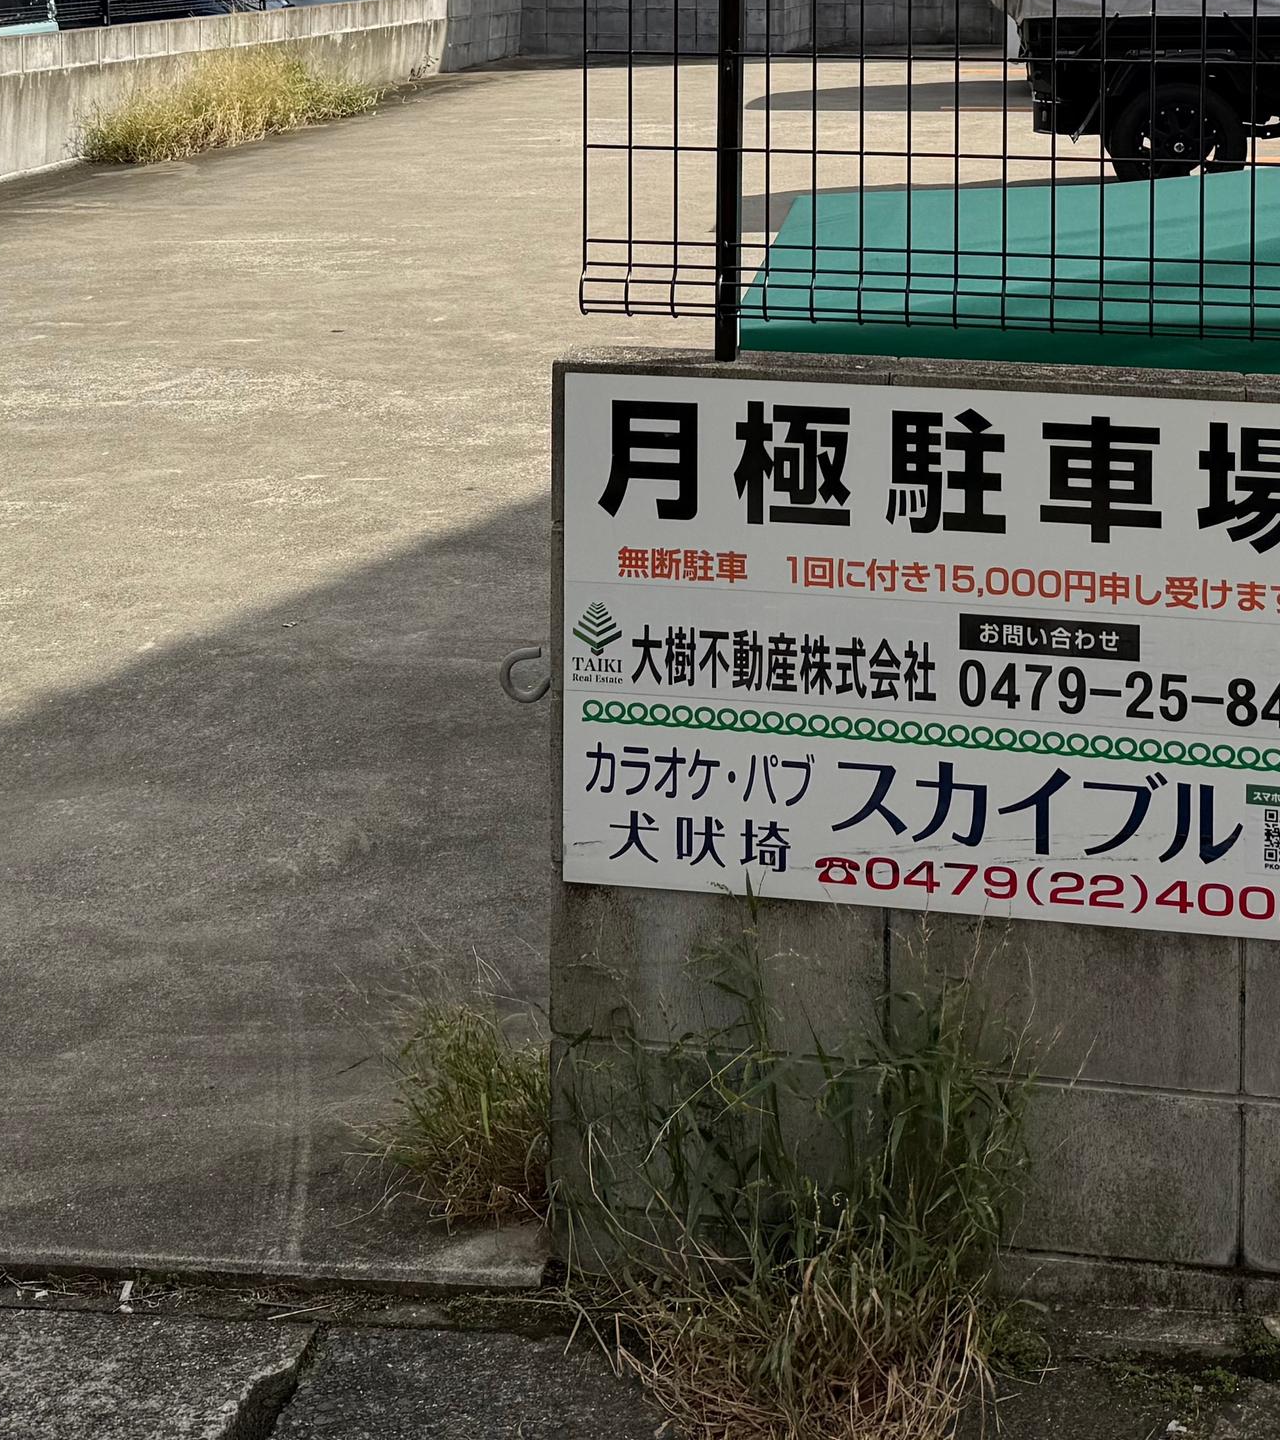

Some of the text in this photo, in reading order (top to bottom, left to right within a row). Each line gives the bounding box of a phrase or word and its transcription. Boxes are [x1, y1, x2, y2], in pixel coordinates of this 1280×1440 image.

[617, 546, 748, 583] 無断駐車
[978, 623, 1120, 652] お問い合わせ
[572, 656, 623, 673] TAIKI
[572, 673, 623, 684] Real Estate
[631, 624, 937, 702] 大樹不動産株式会社
[585, 741, 815, 807] カラオケ・パブ
[831, 760, 1244, 865] スカイブル
[609, 810, 792, 872] 犬吠埼
